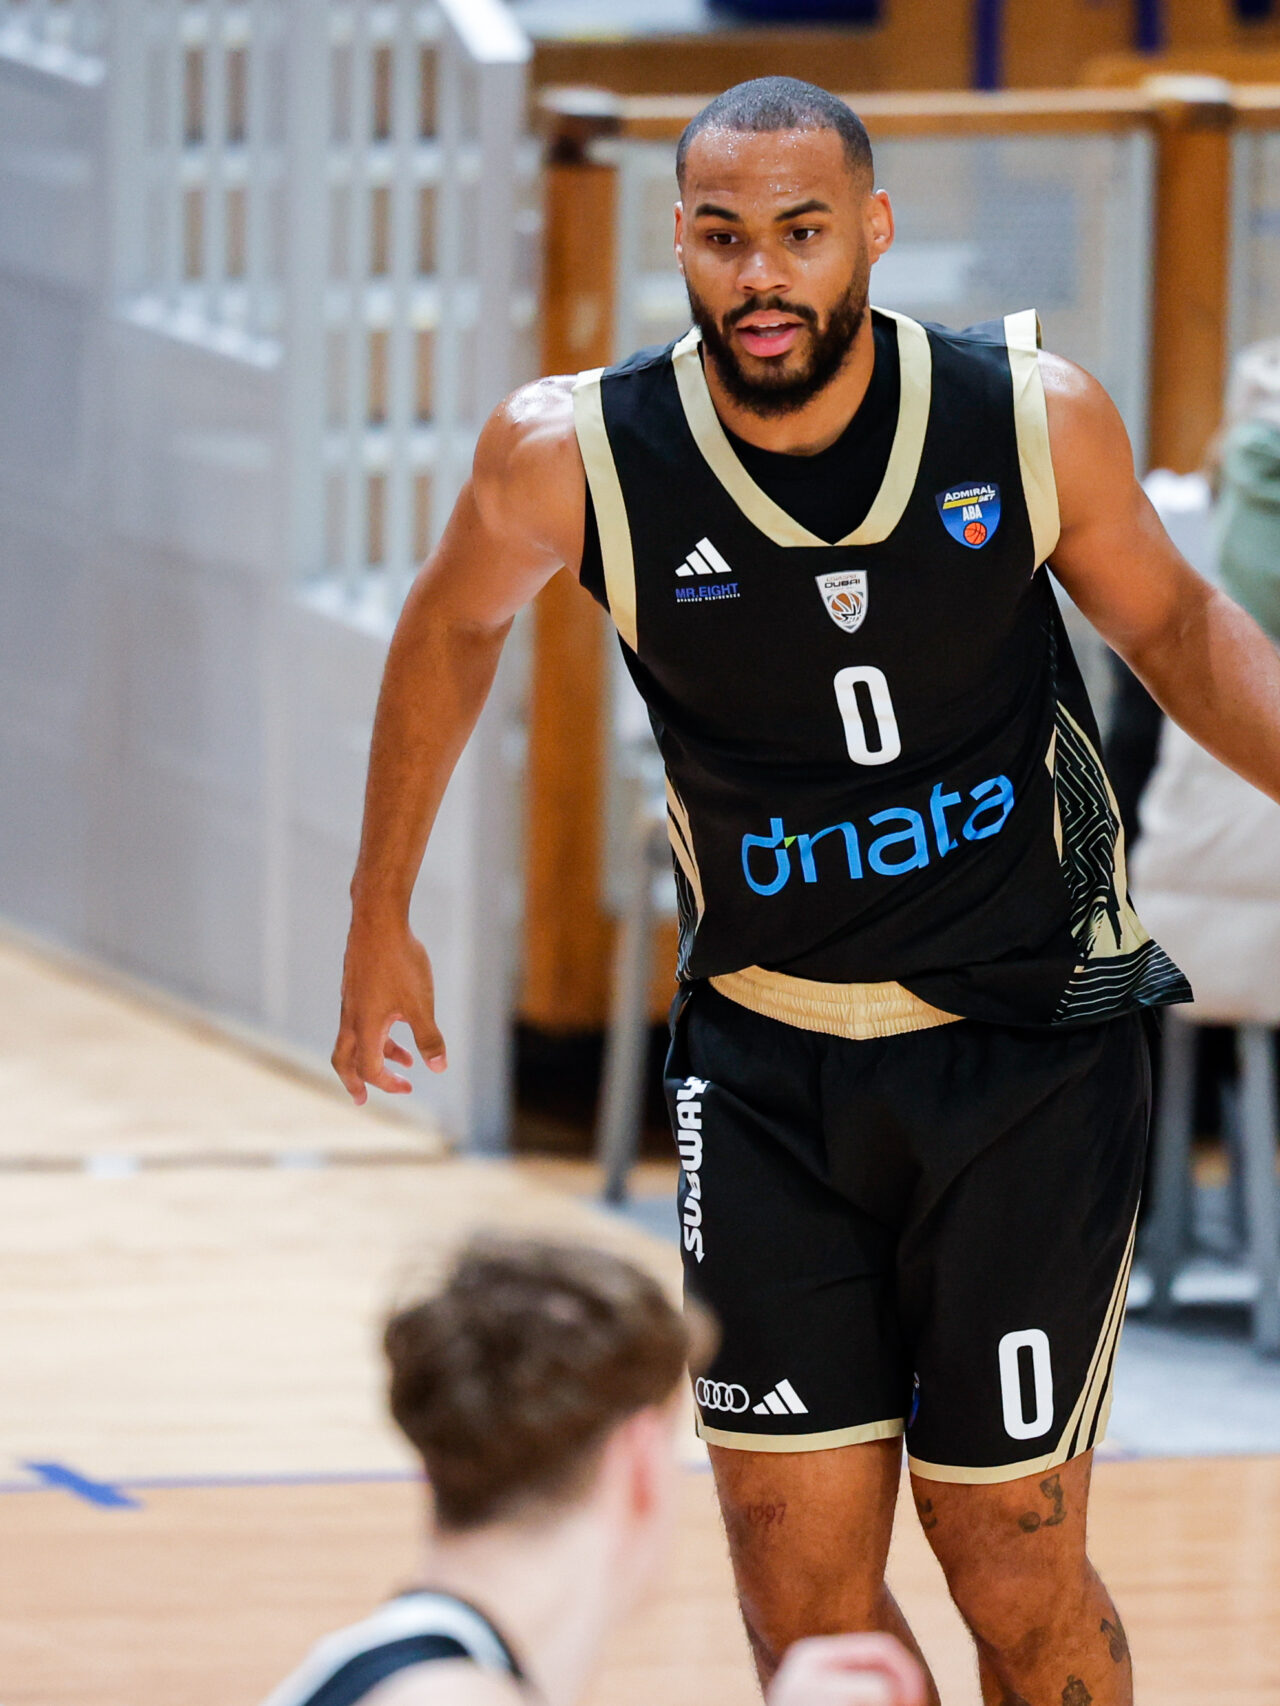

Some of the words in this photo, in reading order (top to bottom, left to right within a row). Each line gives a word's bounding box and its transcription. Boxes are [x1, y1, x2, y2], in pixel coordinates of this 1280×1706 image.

[944, 485, 996, 502] ADMIRAL
[962, 504, 983, 521] ABA
[675, 582, 739, 598] MR.EIGHT
[824, 578, 861, 589] DUBAI
[833, 665, 901, 766] 0
[741, 774, 1014, 897] dnata
[676, 1076, 708, 1264] SUBWAY
[998, 1328, 1055, 1441] 0
